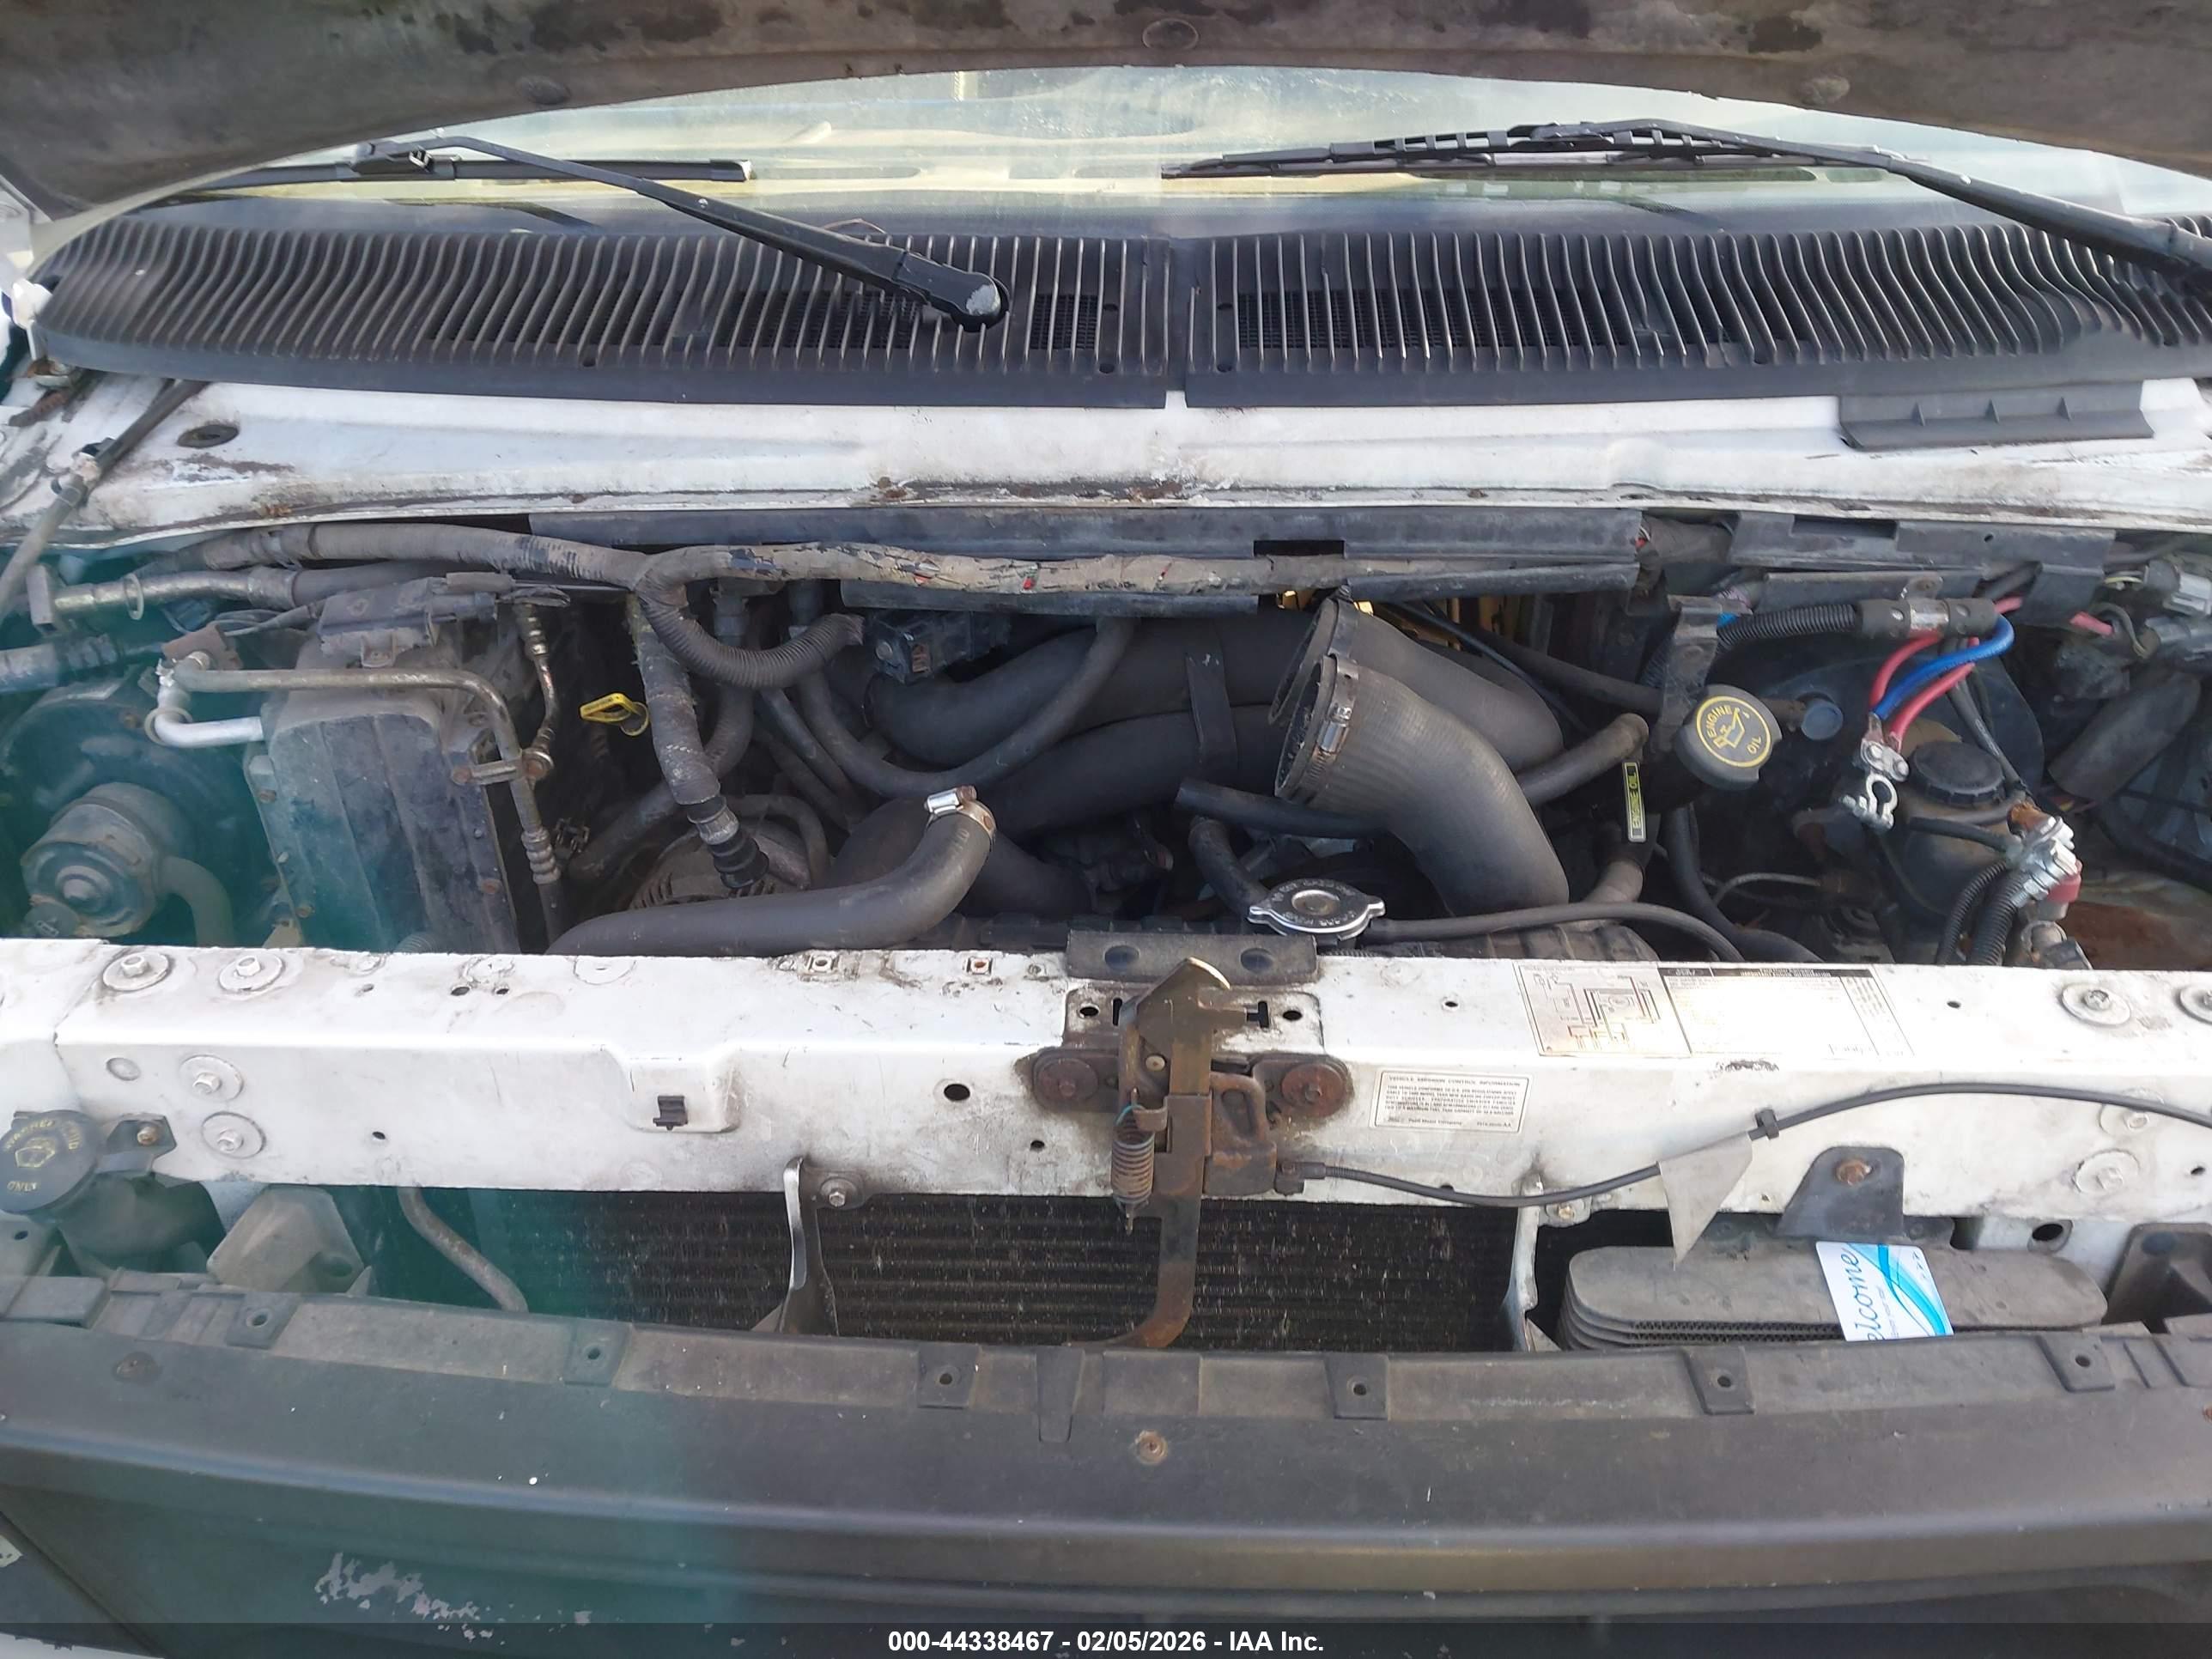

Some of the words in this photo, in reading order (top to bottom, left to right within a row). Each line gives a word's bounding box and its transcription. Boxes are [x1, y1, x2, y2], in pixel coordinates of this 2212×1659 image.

[1705, 704, 1733, 738] ENGINE
[1746, 735, 1762, 755] OIL
[1628, 771, 1638, 790] OL
[7, 1181, 37, 1192] ONLY
[1840, 1247, 1885, 1340] elcome
